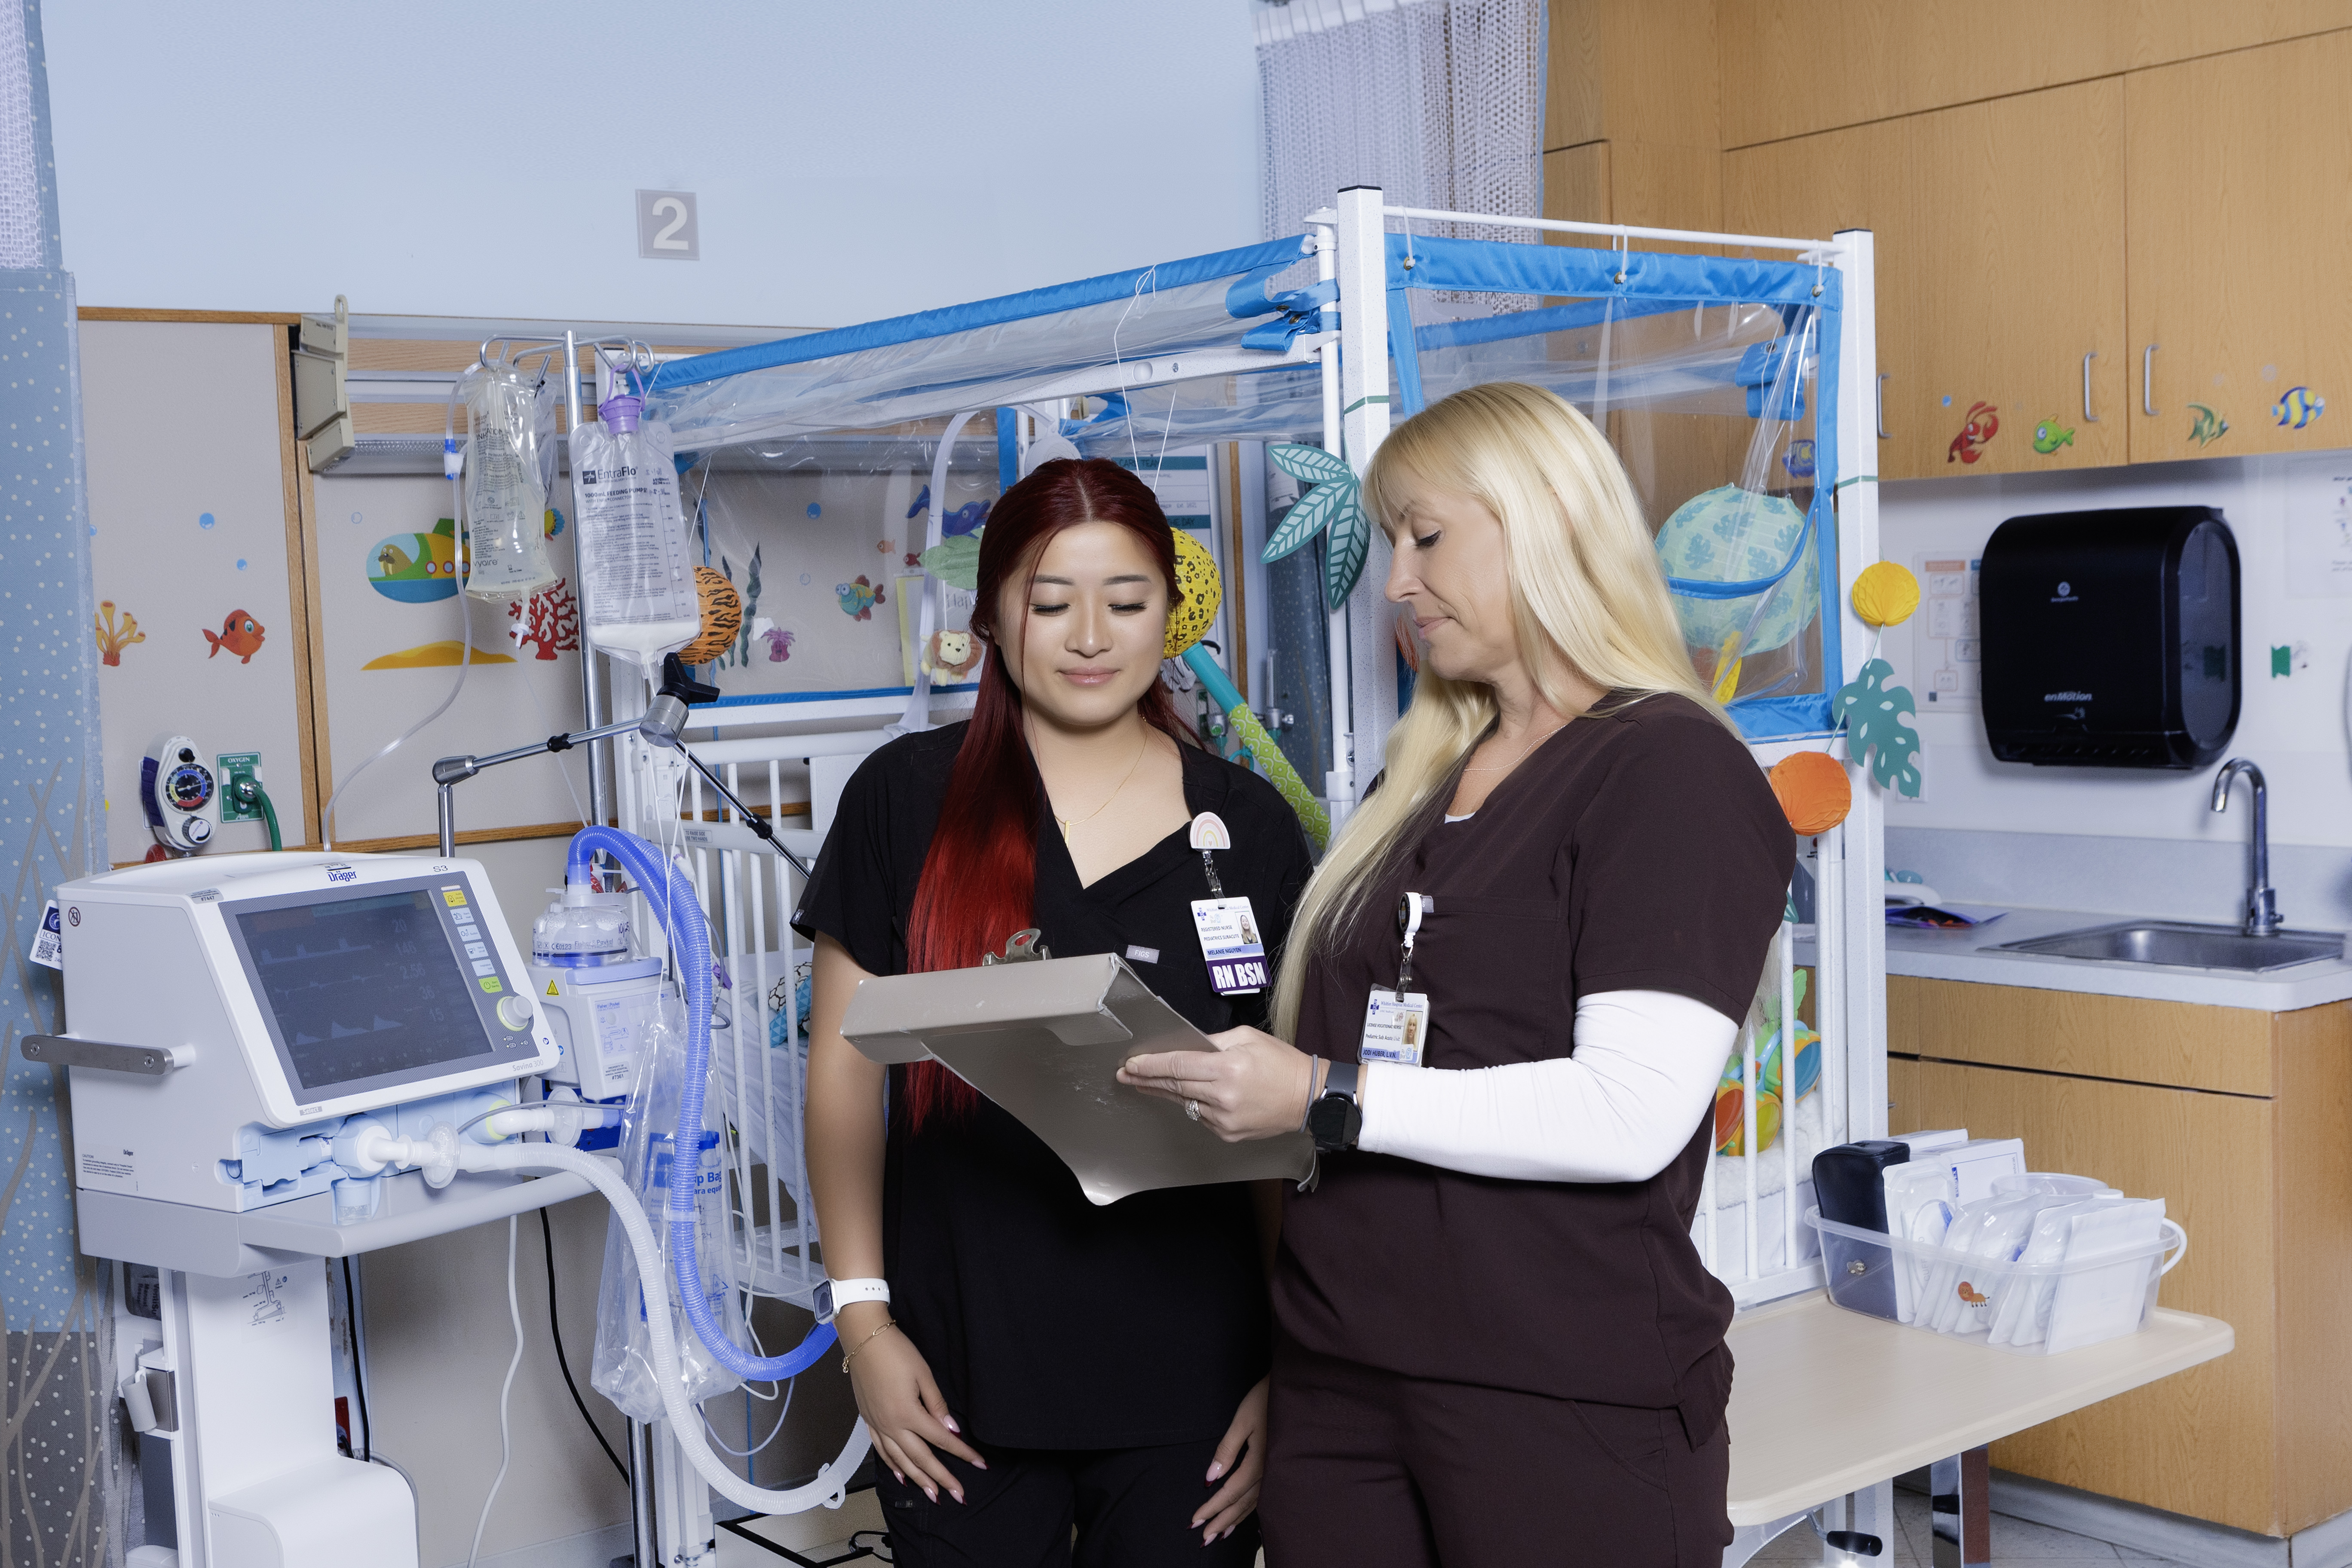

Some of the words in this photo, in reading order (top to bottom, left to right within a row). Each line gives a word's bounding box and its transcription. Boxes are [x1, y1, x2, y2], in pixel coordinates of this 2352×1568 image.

[652, 196, 689, 250] 2
[473, 559, 498, 567] vyaire
[2044, 690, 2092, 702] enMotion
[326, 870, 357, 882] Dräger
[392, 919, 407, 933] 20
[1134, 949, 1150, 958] FIGS
[1212, 965, 1236, 989] RN
[1234, 962, 1267, 986] BSN
[429, 1007, 444, 1022] 15
[512, 1063, 533, 1071] Savina
